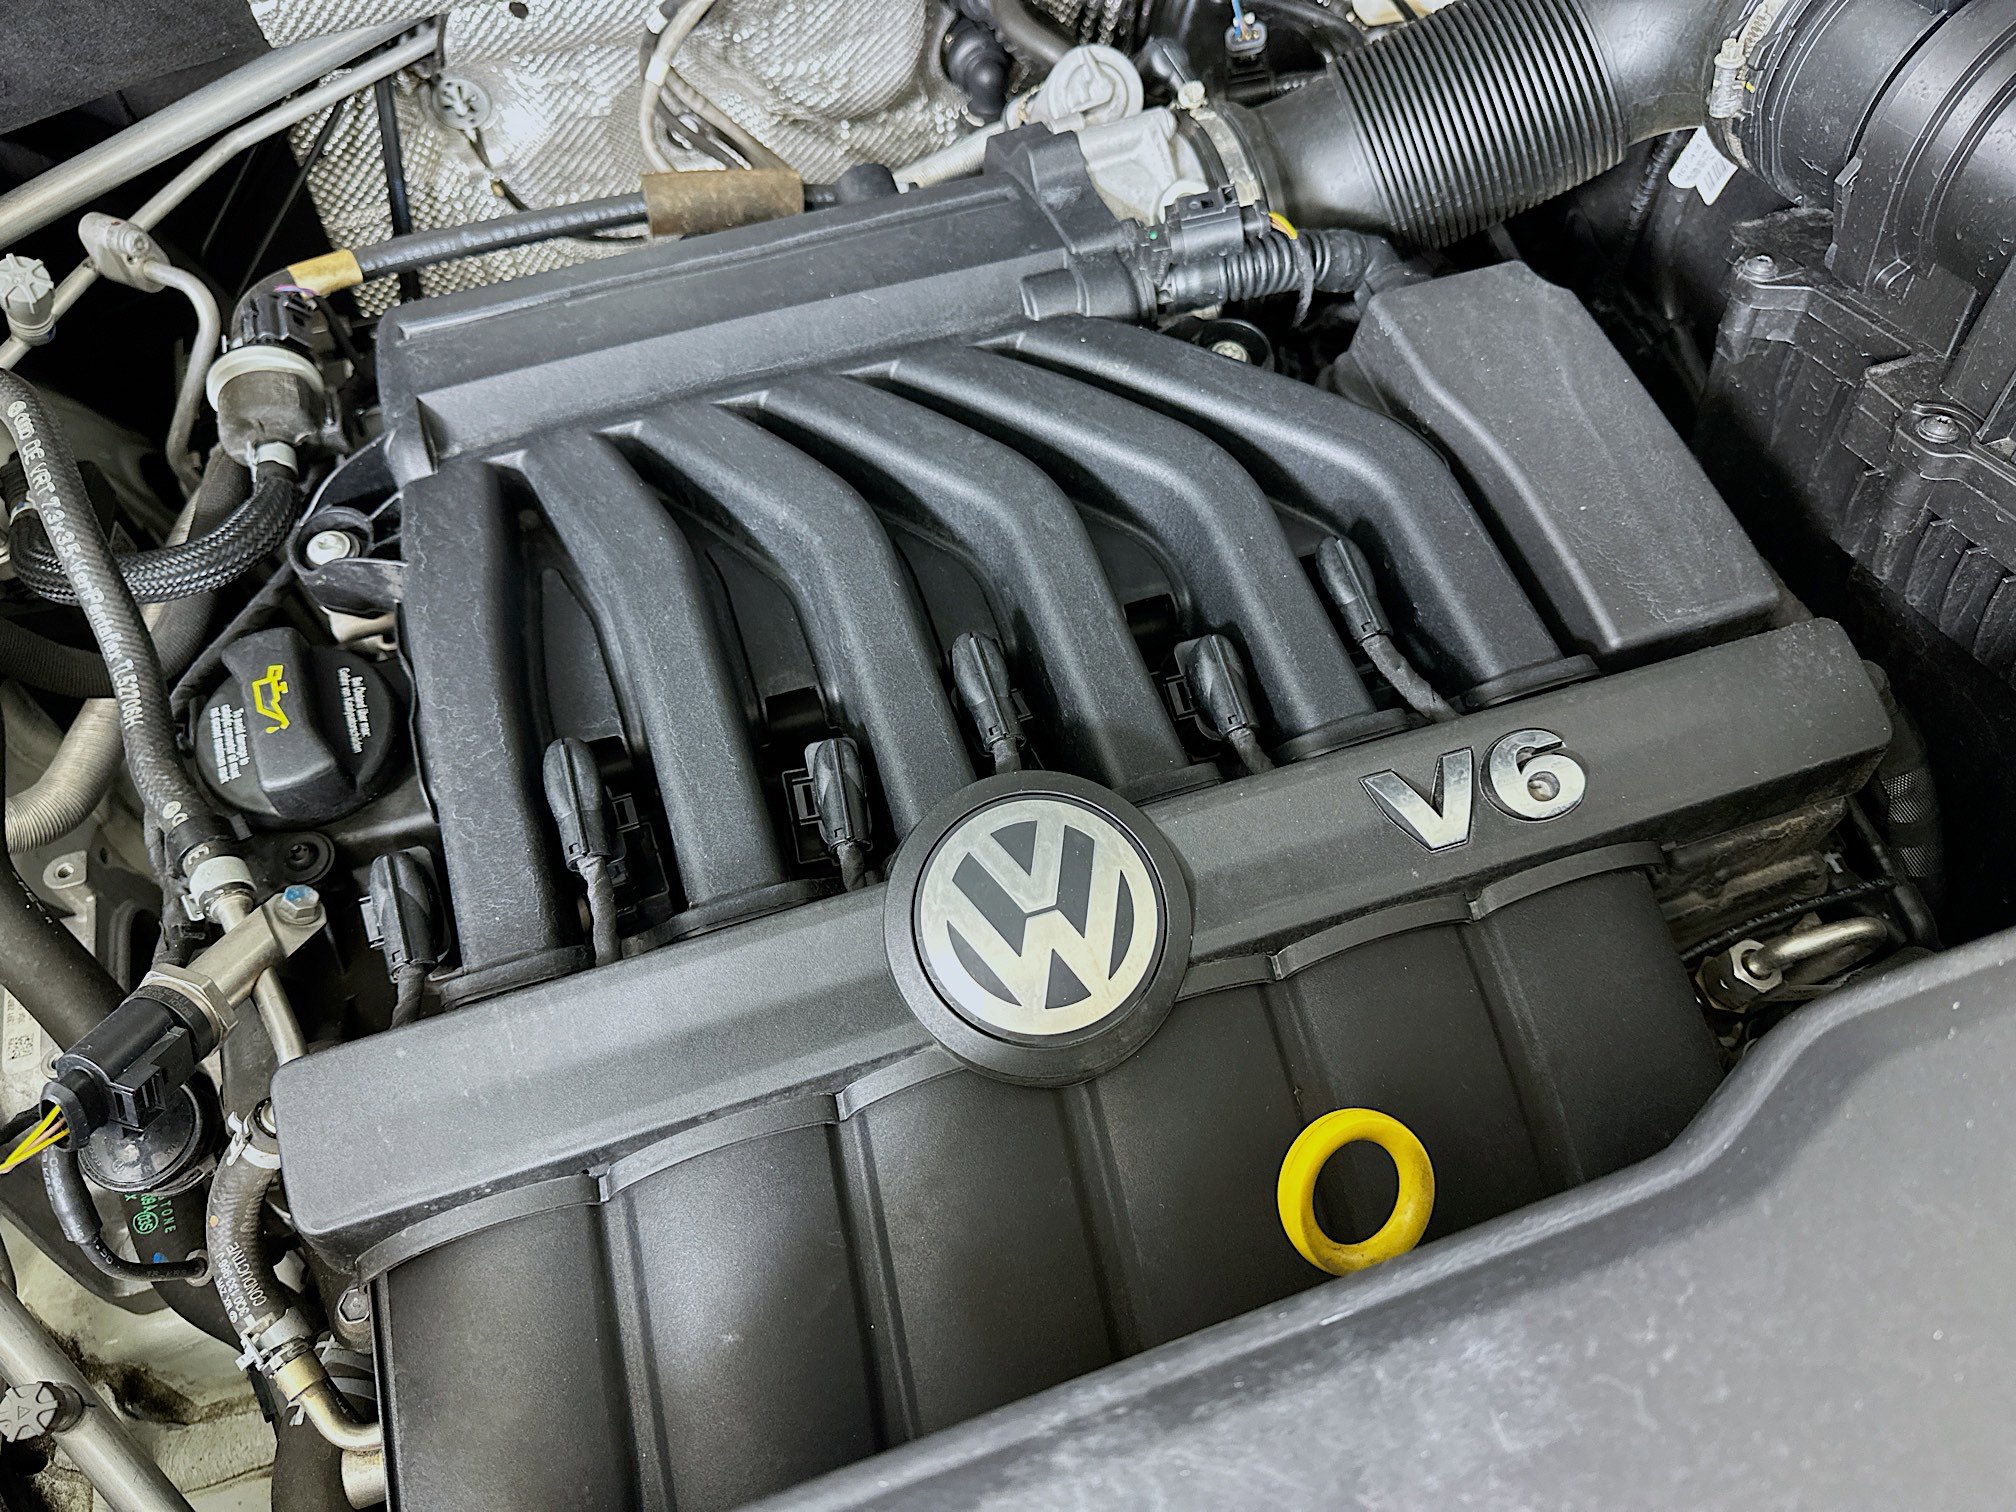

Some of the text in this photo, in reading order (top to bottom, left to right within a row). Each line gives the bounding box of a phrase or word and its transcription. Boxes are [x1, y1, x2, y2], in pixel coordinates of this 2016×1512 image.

[30, 461, 56, 496] VRT
[1358, 728, 1587, 854] V6
[168, 998, 194, 1018] BOSCH
[226, 1241, 268, 1307] CONDUCTIVE
